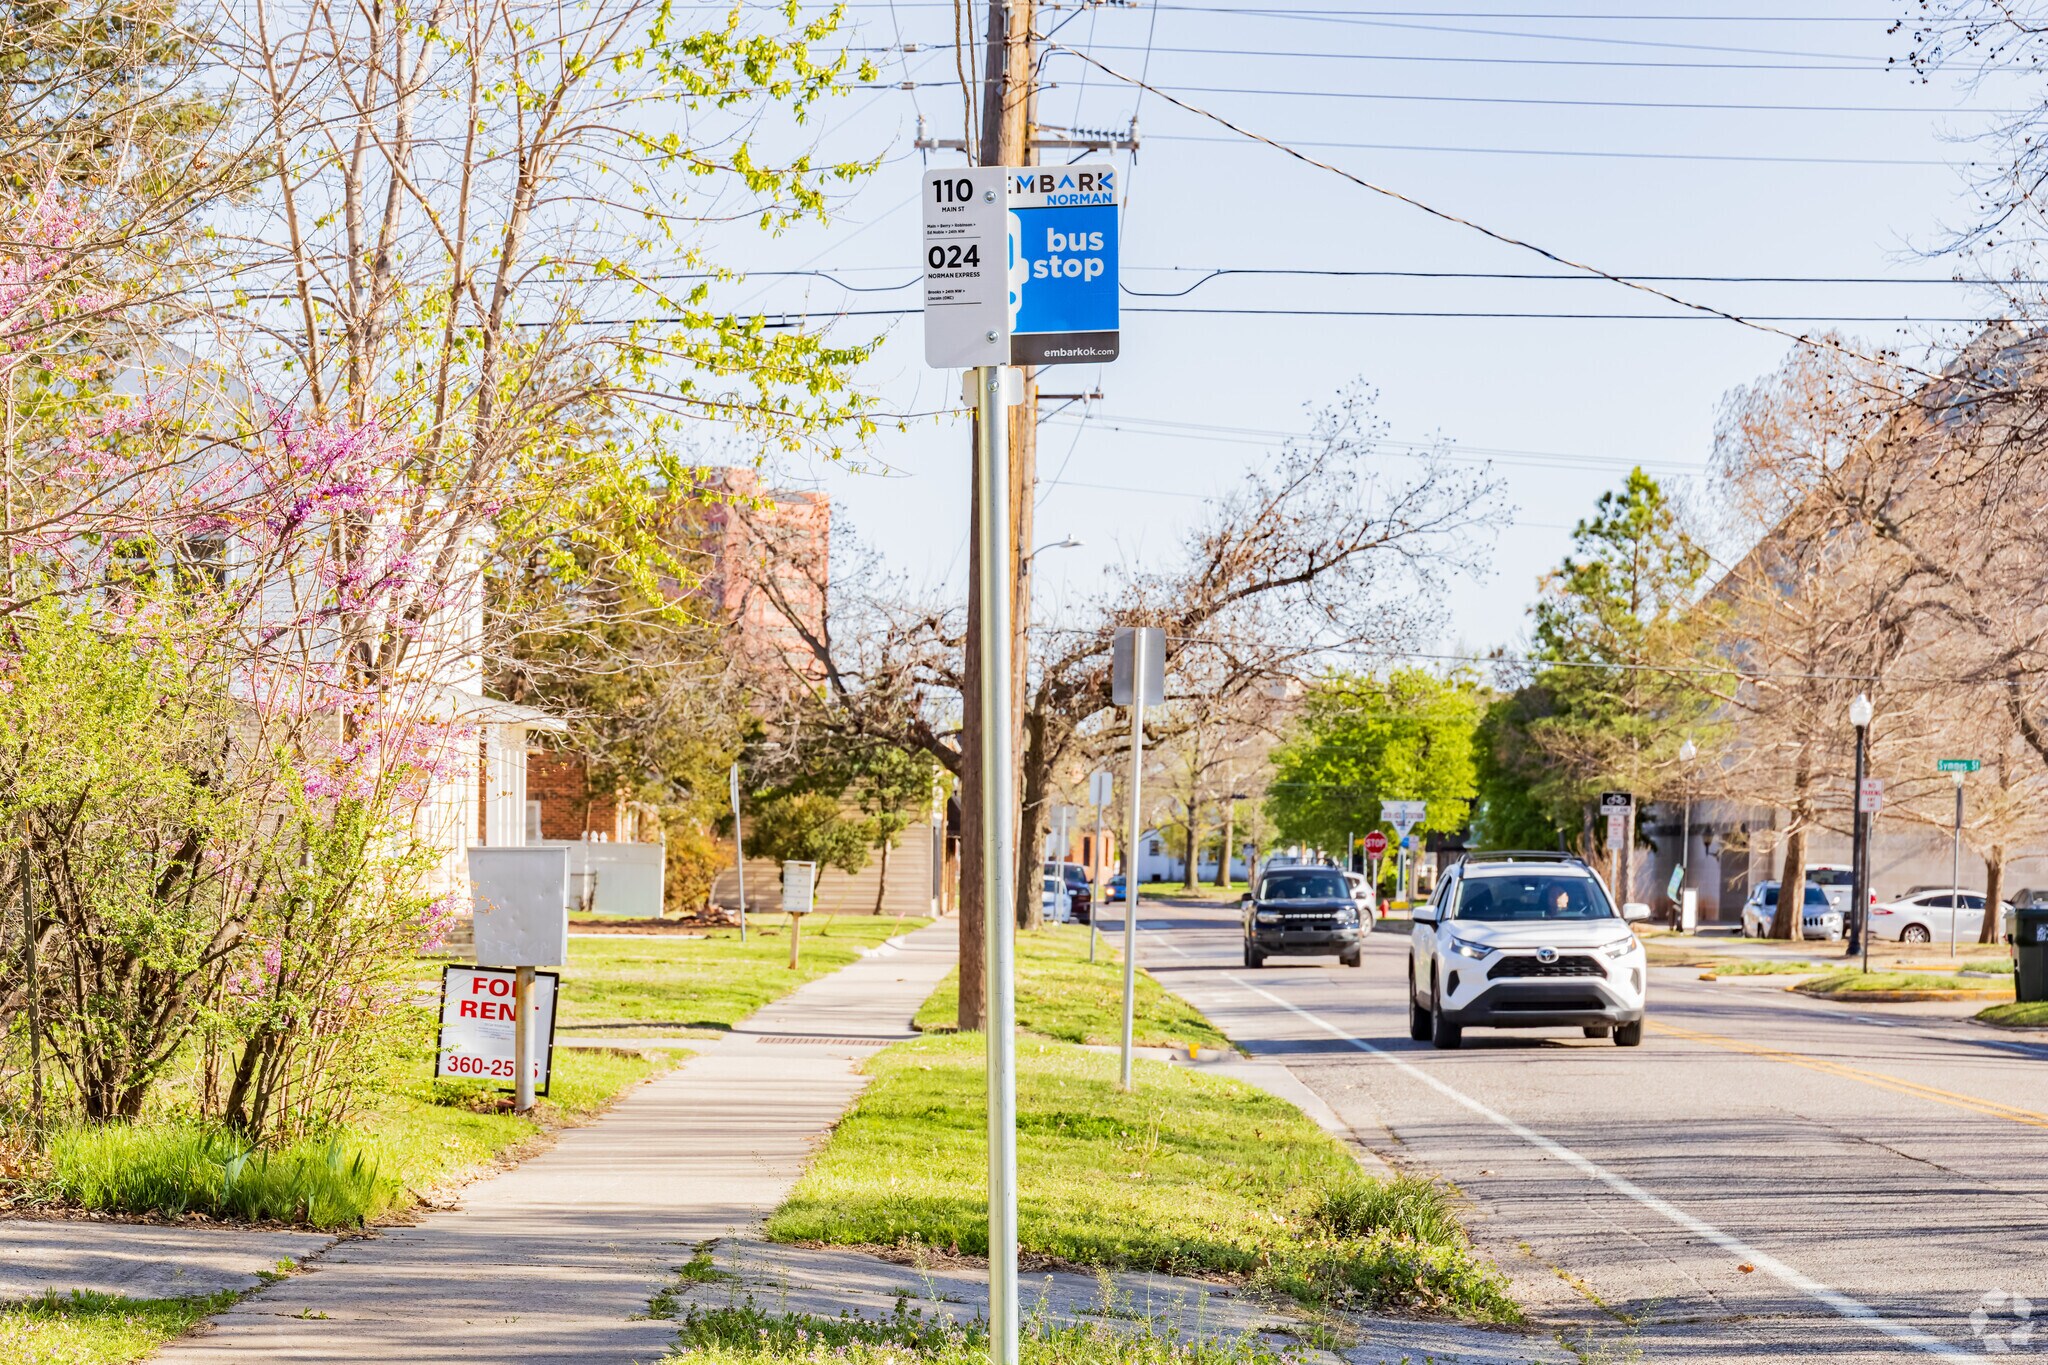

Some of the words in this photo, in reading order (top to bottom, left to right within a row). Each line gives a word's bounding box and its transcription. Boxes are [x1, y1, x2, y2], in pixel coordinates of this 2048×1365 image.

[932, 178, 973, 203] 110
[1047, 193, 1112, 206] NORMAN
[1047, 227, 1104, 253] bus
[928, 244, 980, 269] 024
[1033, 255, 1104, 282] stop
[1044, 346, 1115, 357] embarkok.com
[1971, 760, 1980, 771] St
[1365, 838, 1387, 848] STOP
[460, 1000, 539, 1022] REN
[447, 1055, 539, 1079] 360-25
